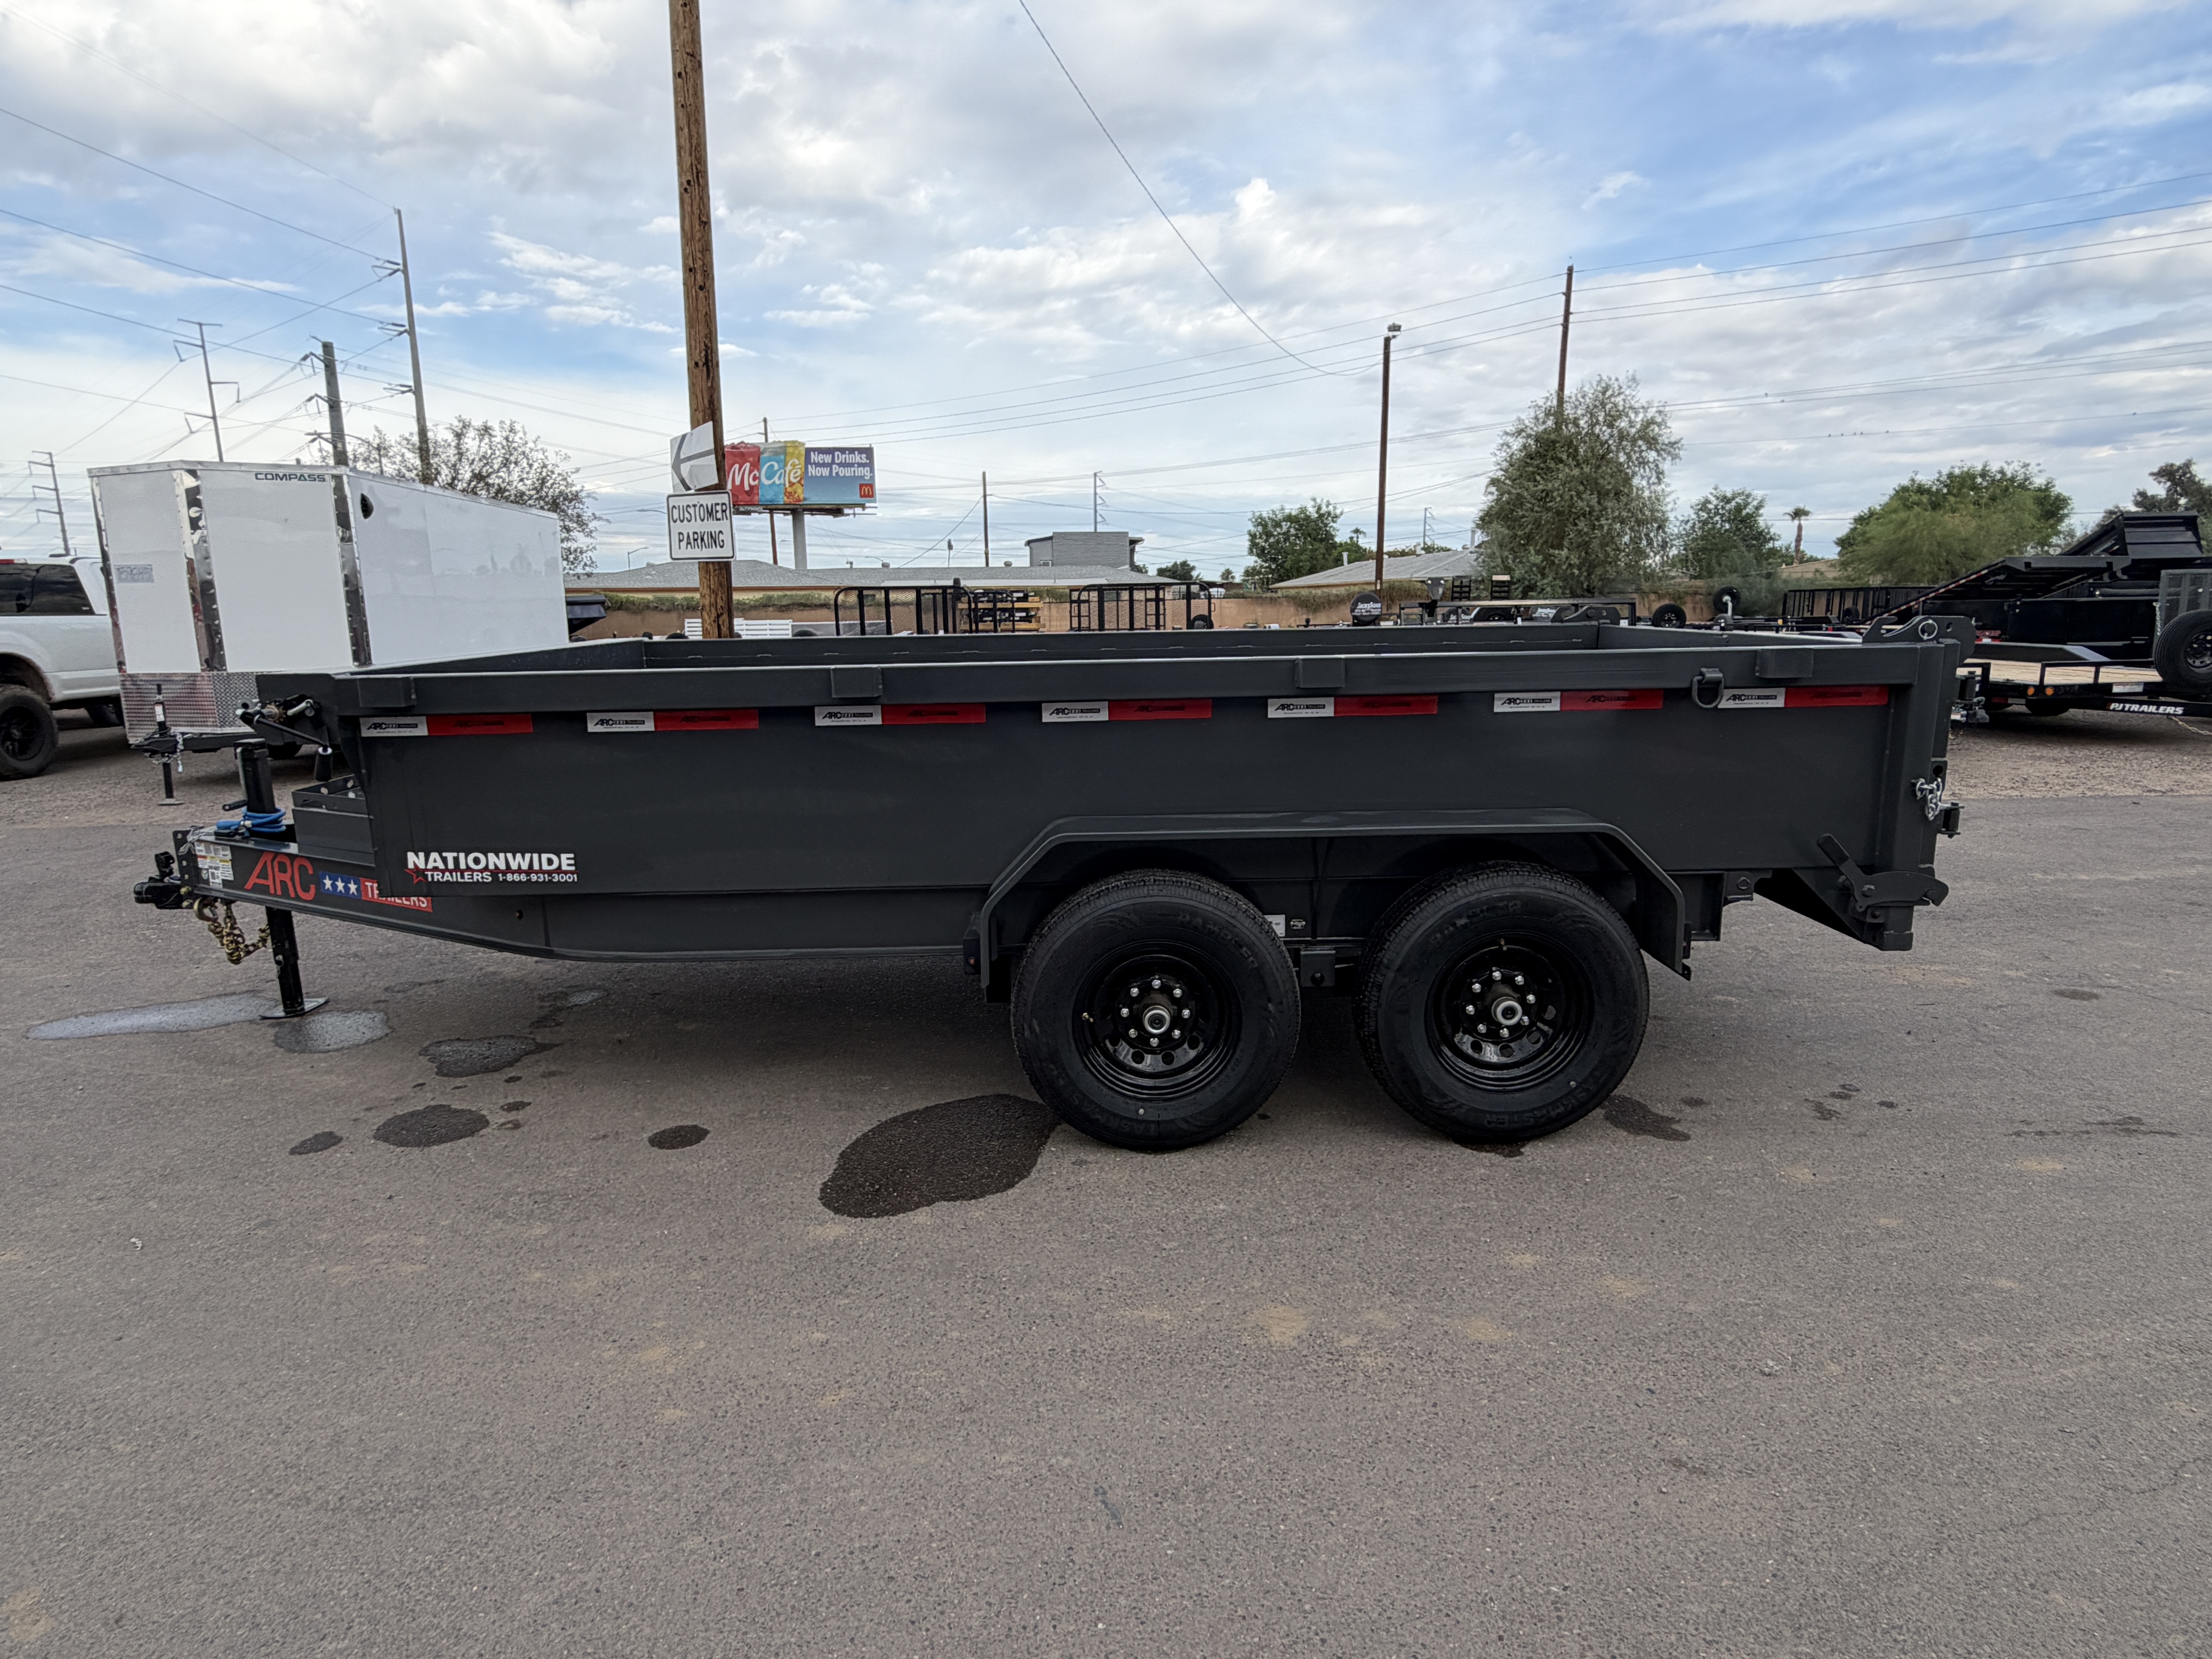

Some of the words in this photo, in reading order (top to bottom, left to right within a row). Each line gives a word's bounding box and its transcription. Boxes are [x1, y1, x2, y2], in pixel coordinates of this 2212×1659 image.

[810, 452, 832, 463] New
[835, 450, 869, 463] Drinks.
[255, 472, 326, 482] COMPASS
[728, 459, 802, 491] McCafé
[808, 465, 832, 477] Now
[832, 464, 873, 480] Pouring.
[672, 502, 728, 523] CUSTOMER
[678, 530, 725, 550] PARKING
[1049, 708, 1069, 716] ARC
[2124, 704, 2185, 714] TRAILERS
[407, 852, 576, 871] NATIONWIDE
[244, 851, 316, 901] ARC
[425, 871, 492, 882] TRAILERS
[498, 873, 578, 882] 1-866-931-3001
[365, 882, 428, 908] TERS
